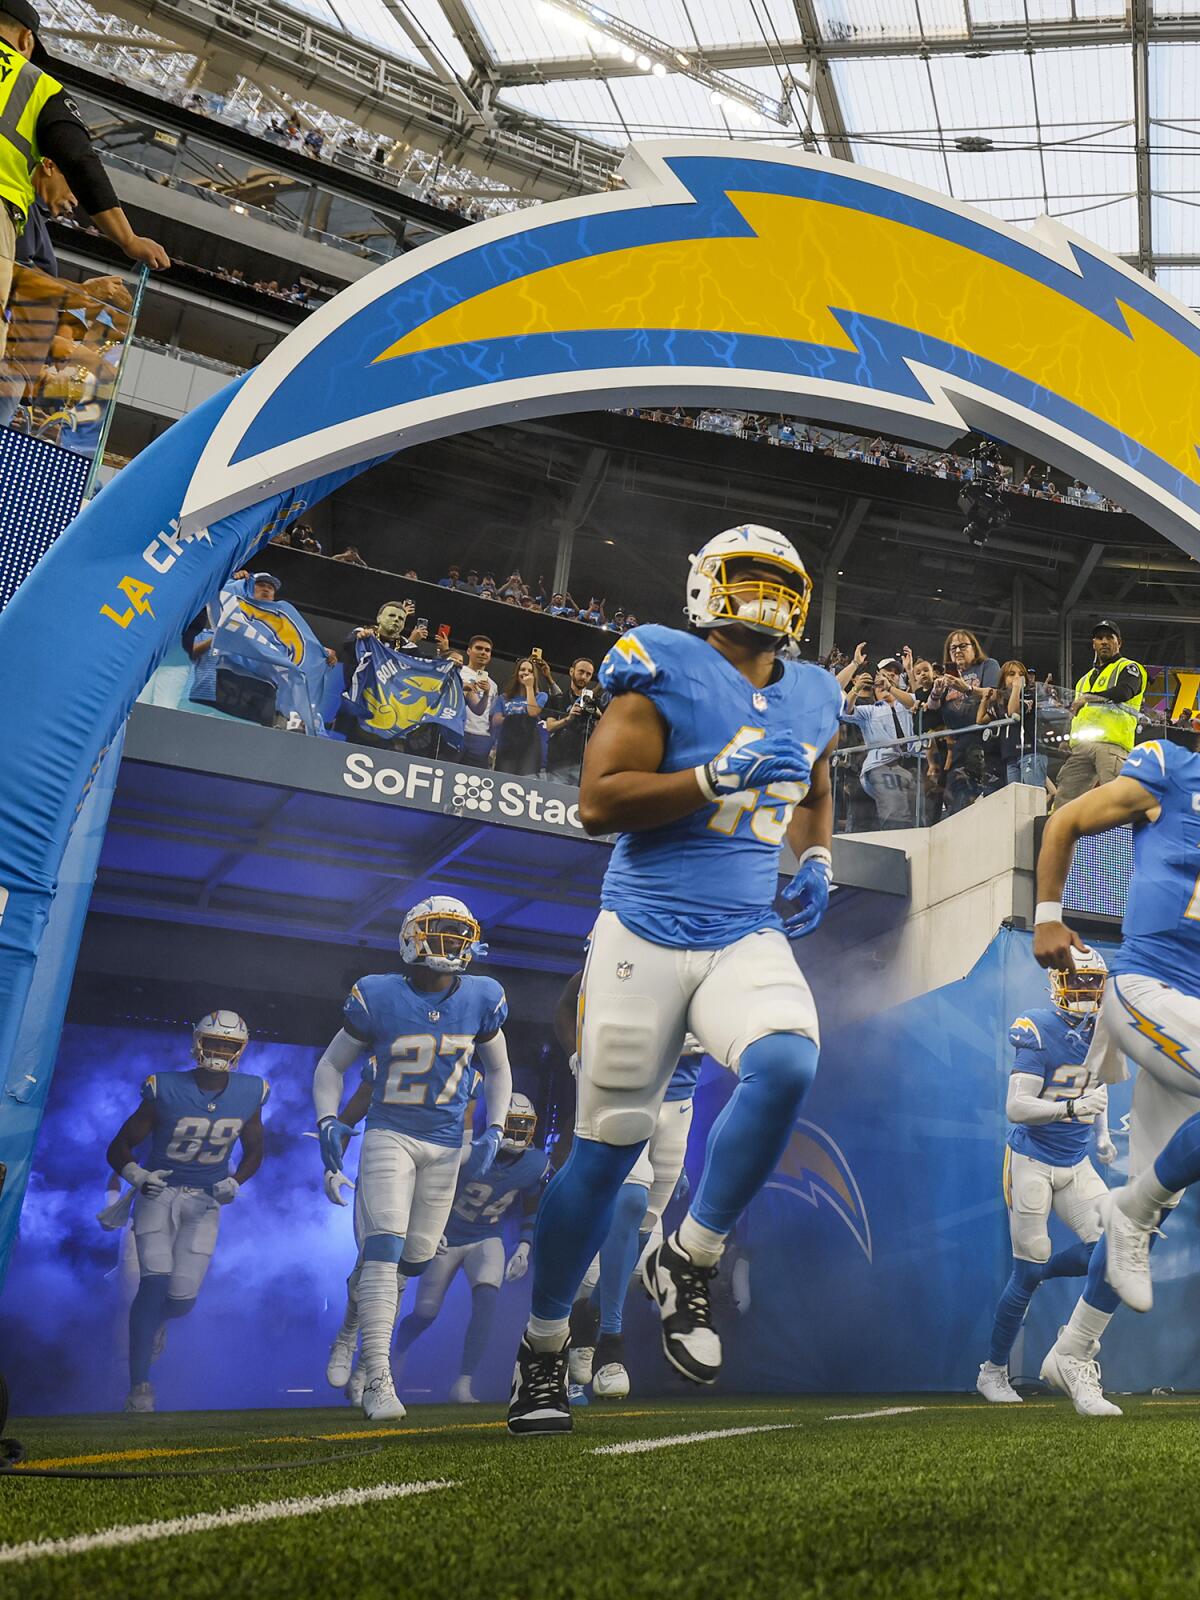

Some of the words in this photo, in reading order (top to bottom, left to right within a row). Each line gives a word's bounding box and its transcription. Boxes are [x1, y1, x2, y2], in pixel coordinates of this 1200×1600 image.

[99, 575, 156, 629] LA
[343, 752, 445, 804] SoFi
[383, 1033, 477, 1105] 27
[1040, 1063, 1099, 1125] 2
[166, 1116, 244, 1164] 89
